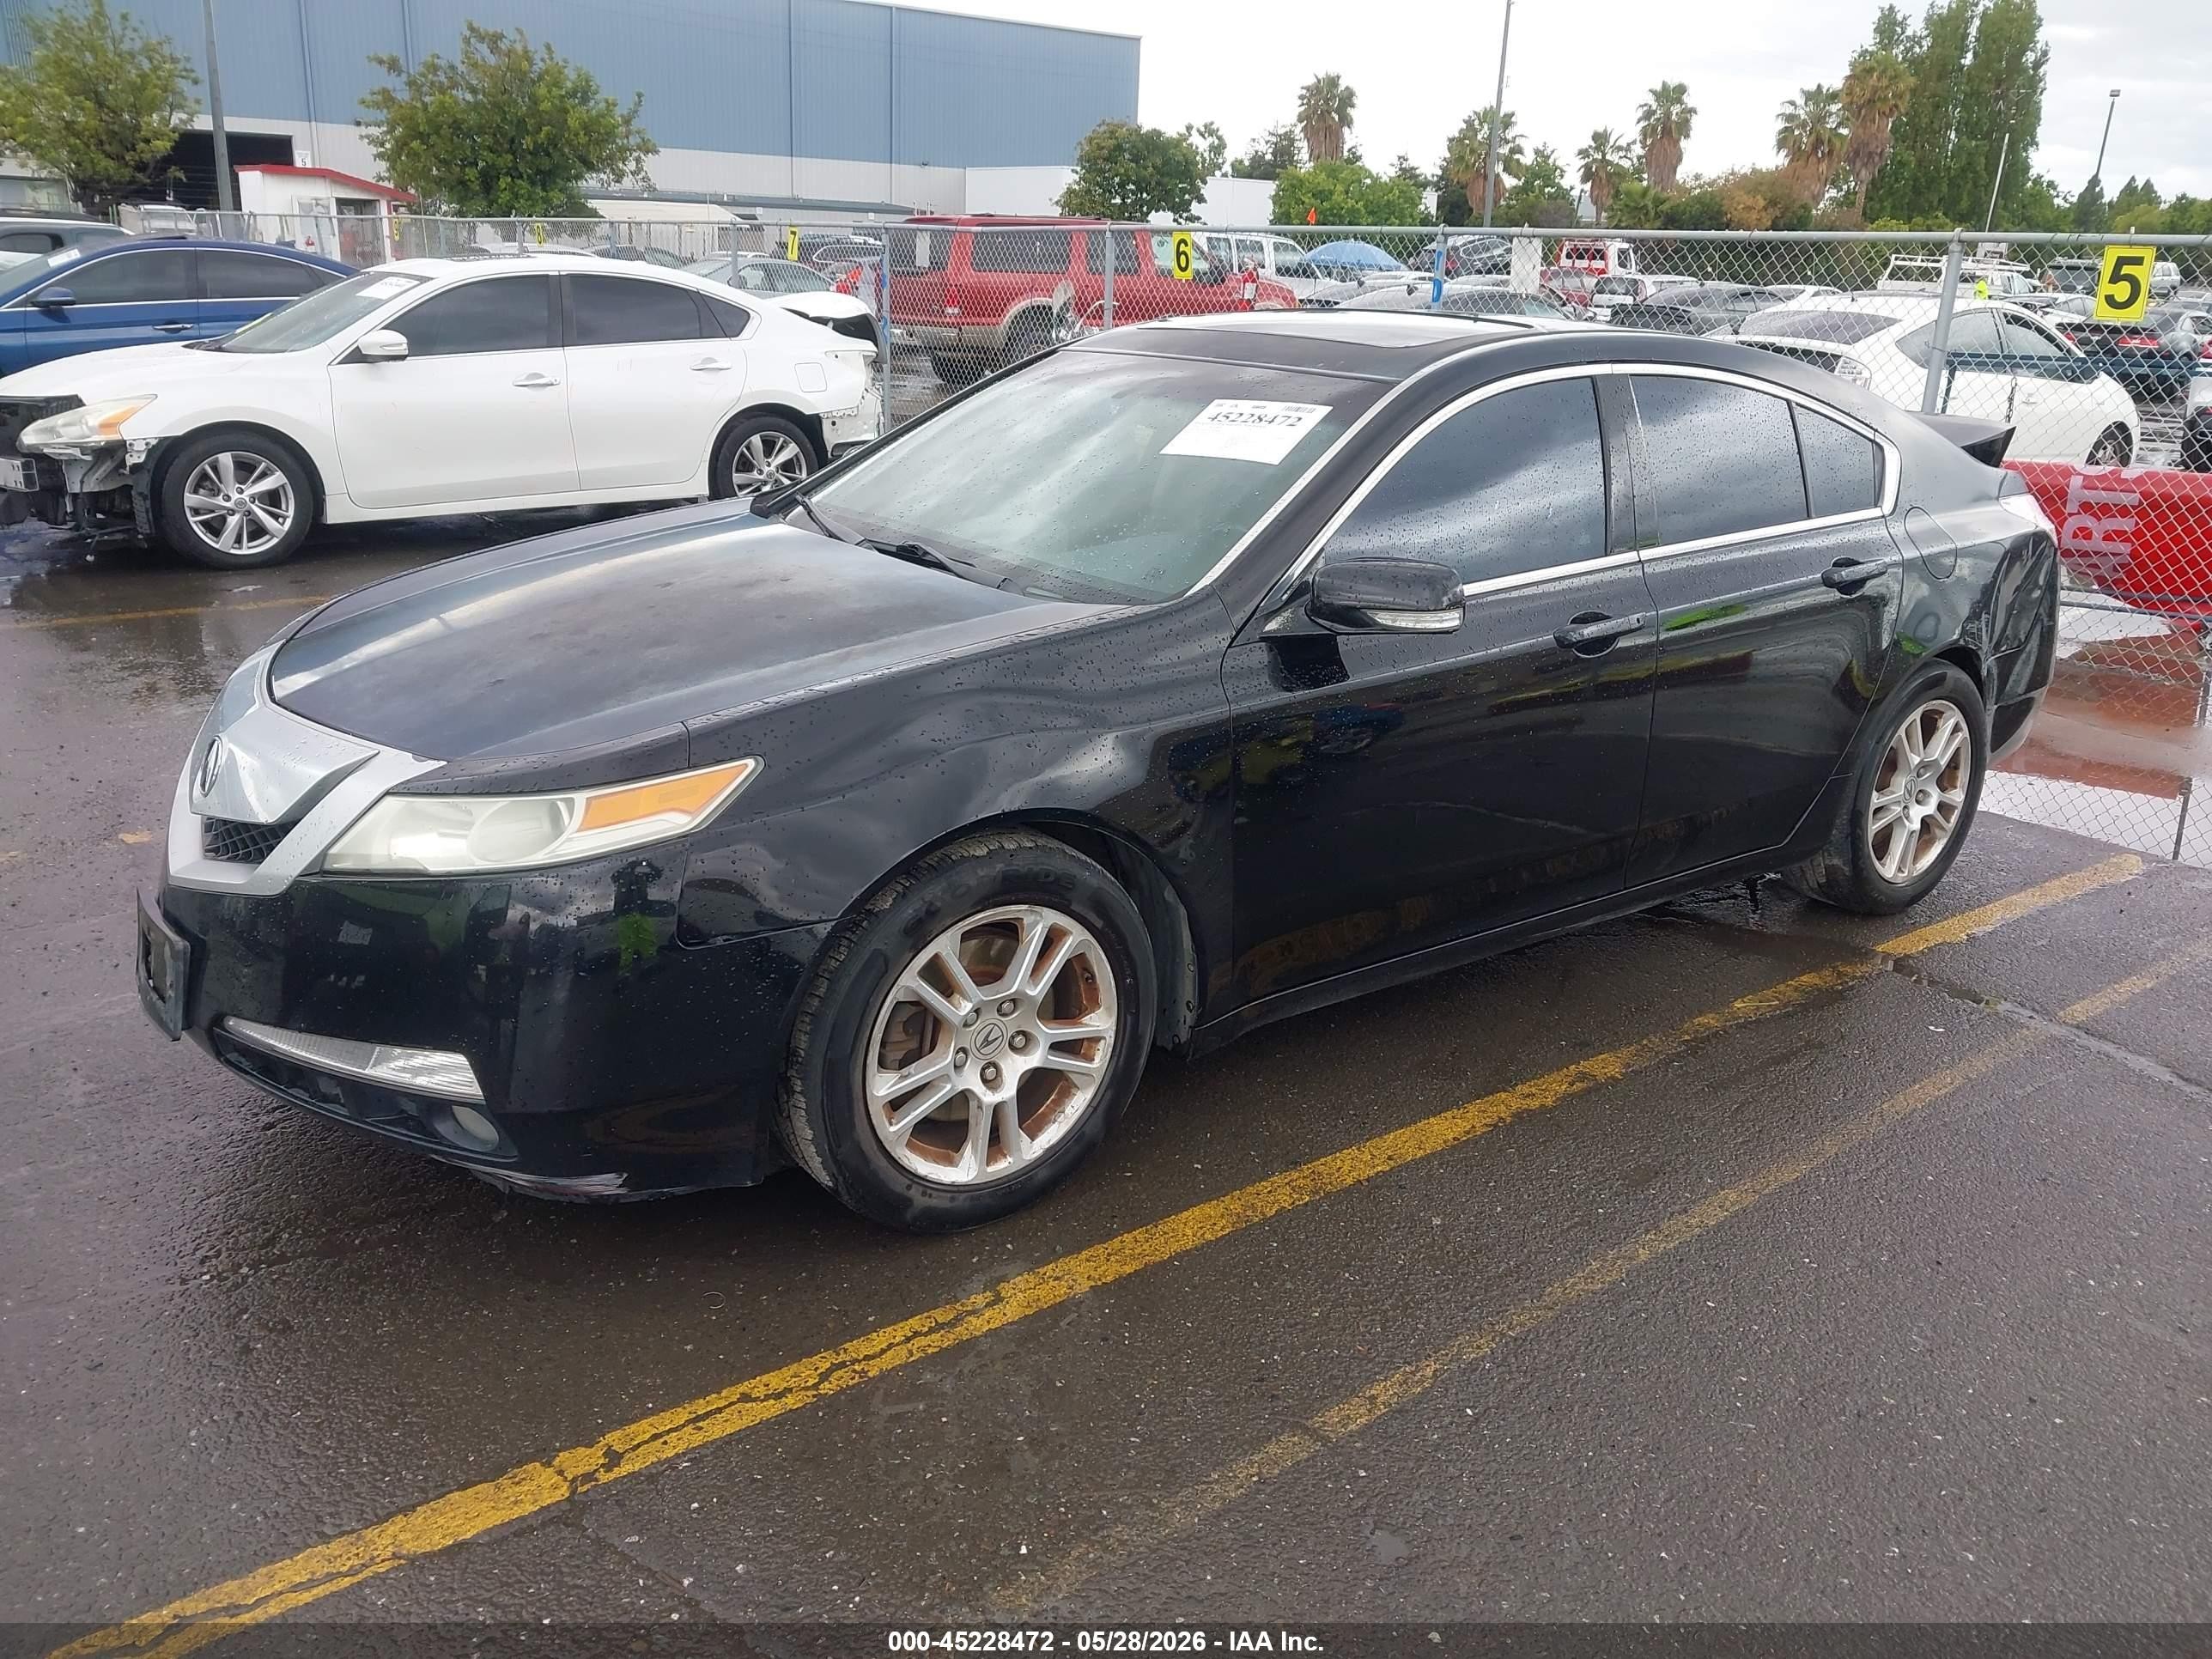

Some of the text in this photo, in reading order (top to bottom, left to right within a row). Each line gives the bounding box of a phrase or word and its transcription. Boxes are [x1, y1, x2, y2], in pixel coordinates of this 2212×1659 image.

[790, 230, 797, 254] 7
[1176, 238, 1189, 272] 6
[2104, 256, 2145, 310] 5
[1207, 412, 1303, 426] 45228472
